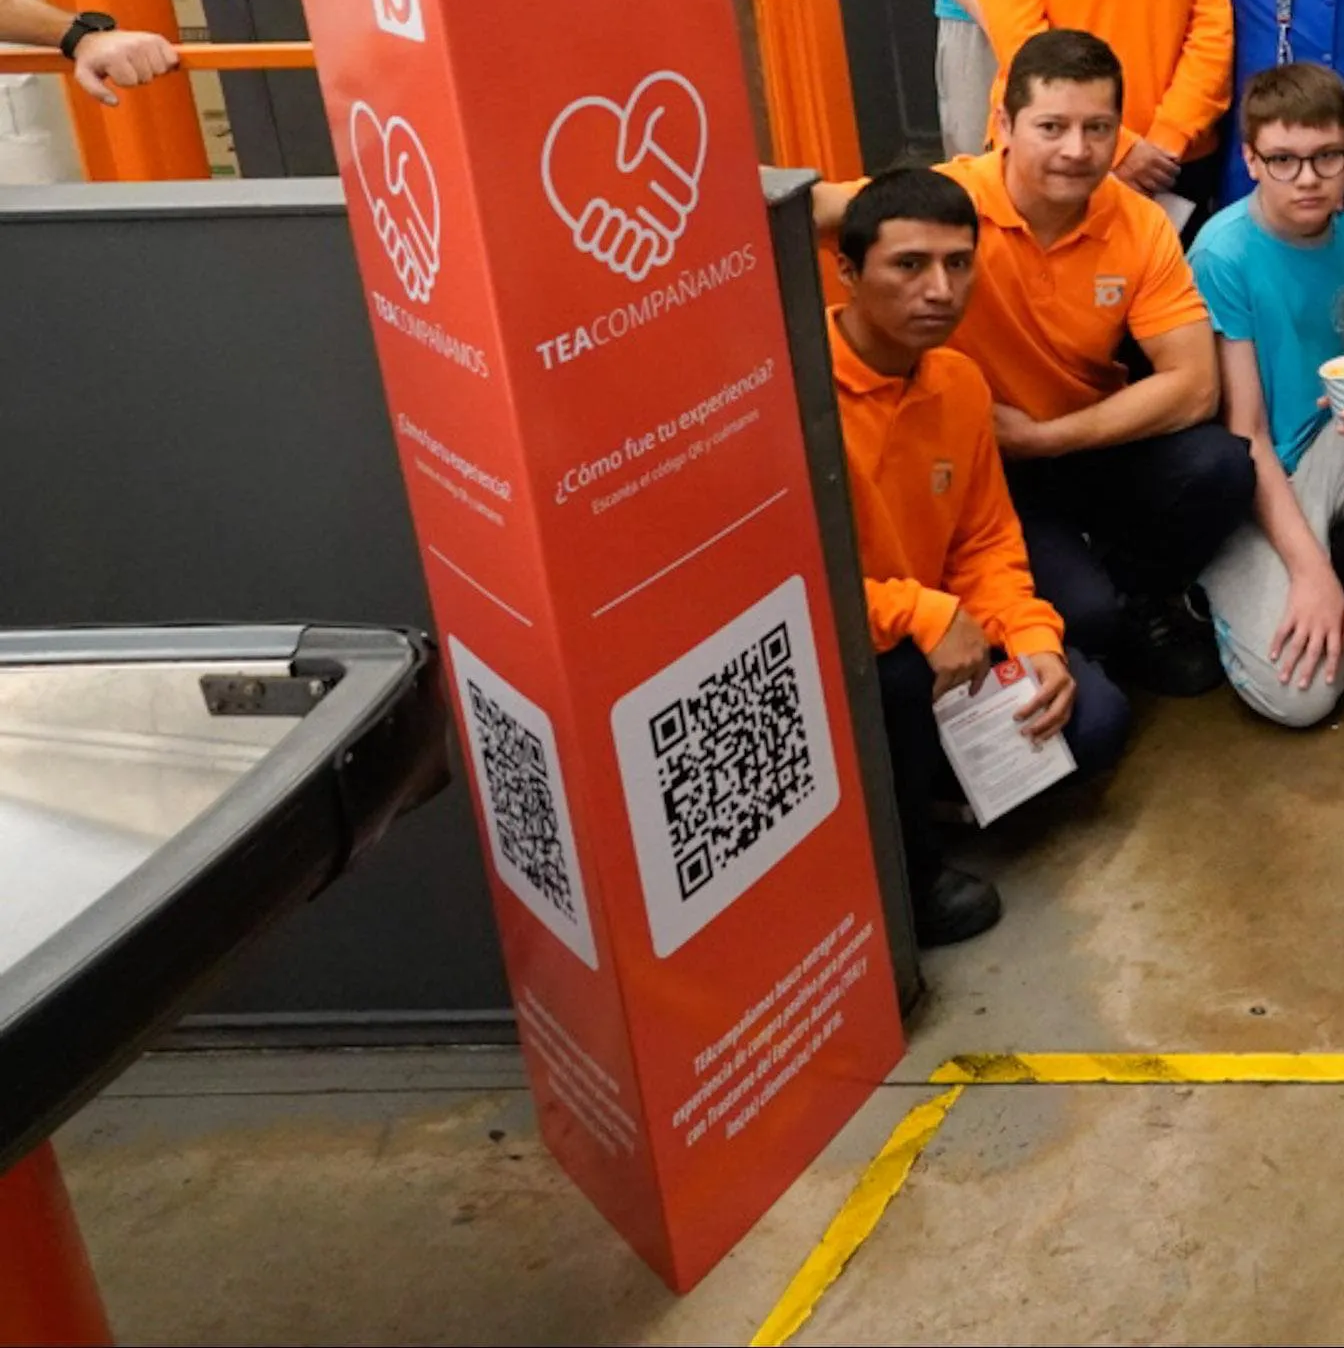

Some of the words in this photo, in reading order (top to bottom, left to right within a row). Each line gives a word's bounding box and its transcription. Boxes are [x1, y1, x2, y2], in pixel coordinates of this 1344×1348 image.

[536, 244, 757, 370] TEACOMPAÑAMOS
[555, 451, 623, 505] ¿Cómo
[625, 433, 656, 461] fue
[658, 419, 678, 442] tu
[678, 358, 774, 430] experiencia?
